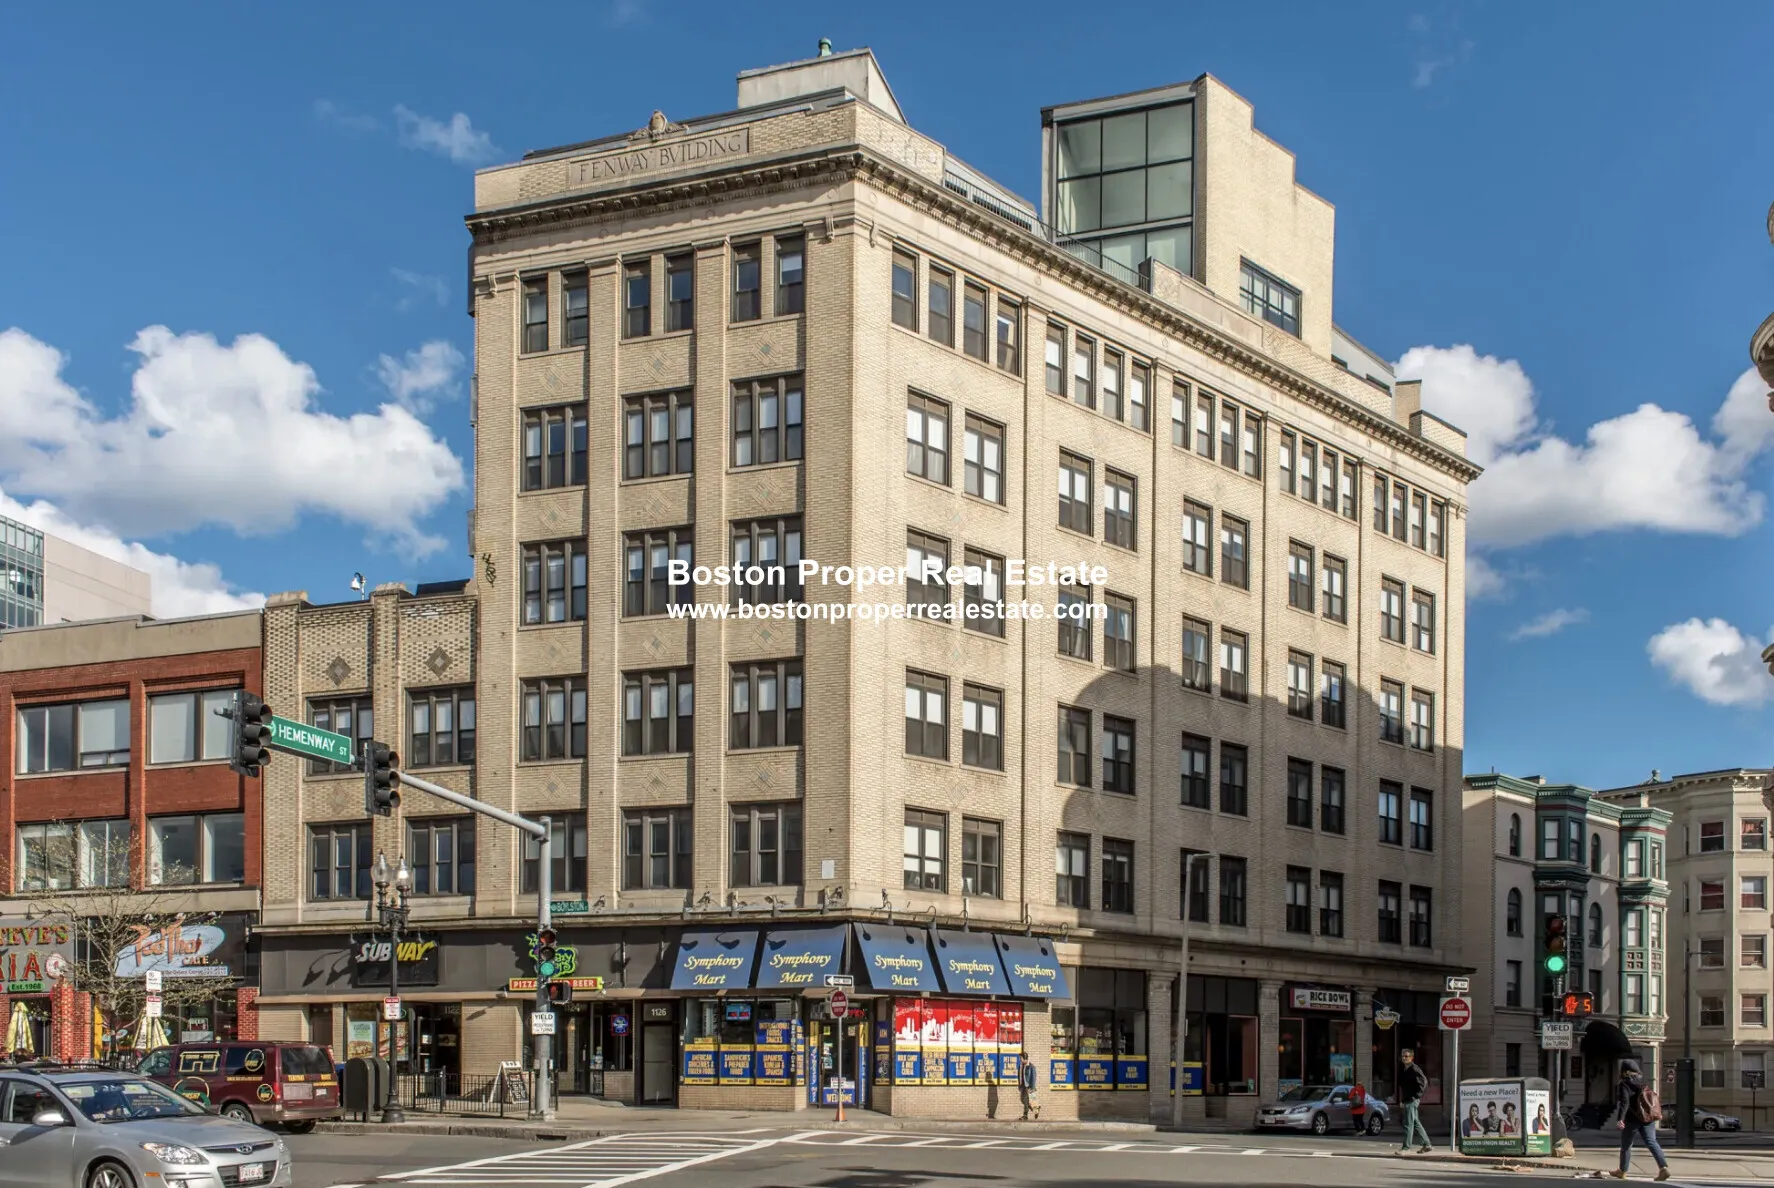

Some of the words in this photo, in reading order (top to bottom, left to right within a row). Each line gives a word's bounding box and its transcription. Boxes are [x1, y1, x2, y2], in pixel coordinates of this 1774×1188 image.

[579, 151, 654, 182] FENWAY
[278, 724, 336, 752] HEMENWAY
[339, 746, 347, 756] ST
[0, 952, 43, 980] IA
[683, 953, 744, 970] Symphony
[769, 951, 831, 969] Symphony
[875, 954, 924, 971] Symphony
[949, 959, 994, 976] Symphony
[1014, 964, 1056, 980] Symphony
[694, 973, 727, 986] Mart
[781, 972, 814, 984] Mart
[892, 974, 919, 987] Mart
[964, 978, 990, 990] Mart
[1029, 982, 1053, 994] Mart
[1310, 992, 1327, 1002] RICE
[1328, 992, 1348, 1004] BOWL
[651, 1008, 667, 1016] 1126
[1584, 1000, 1591, 1012] 5
[826, 1093, 852, 1103] WELOME
